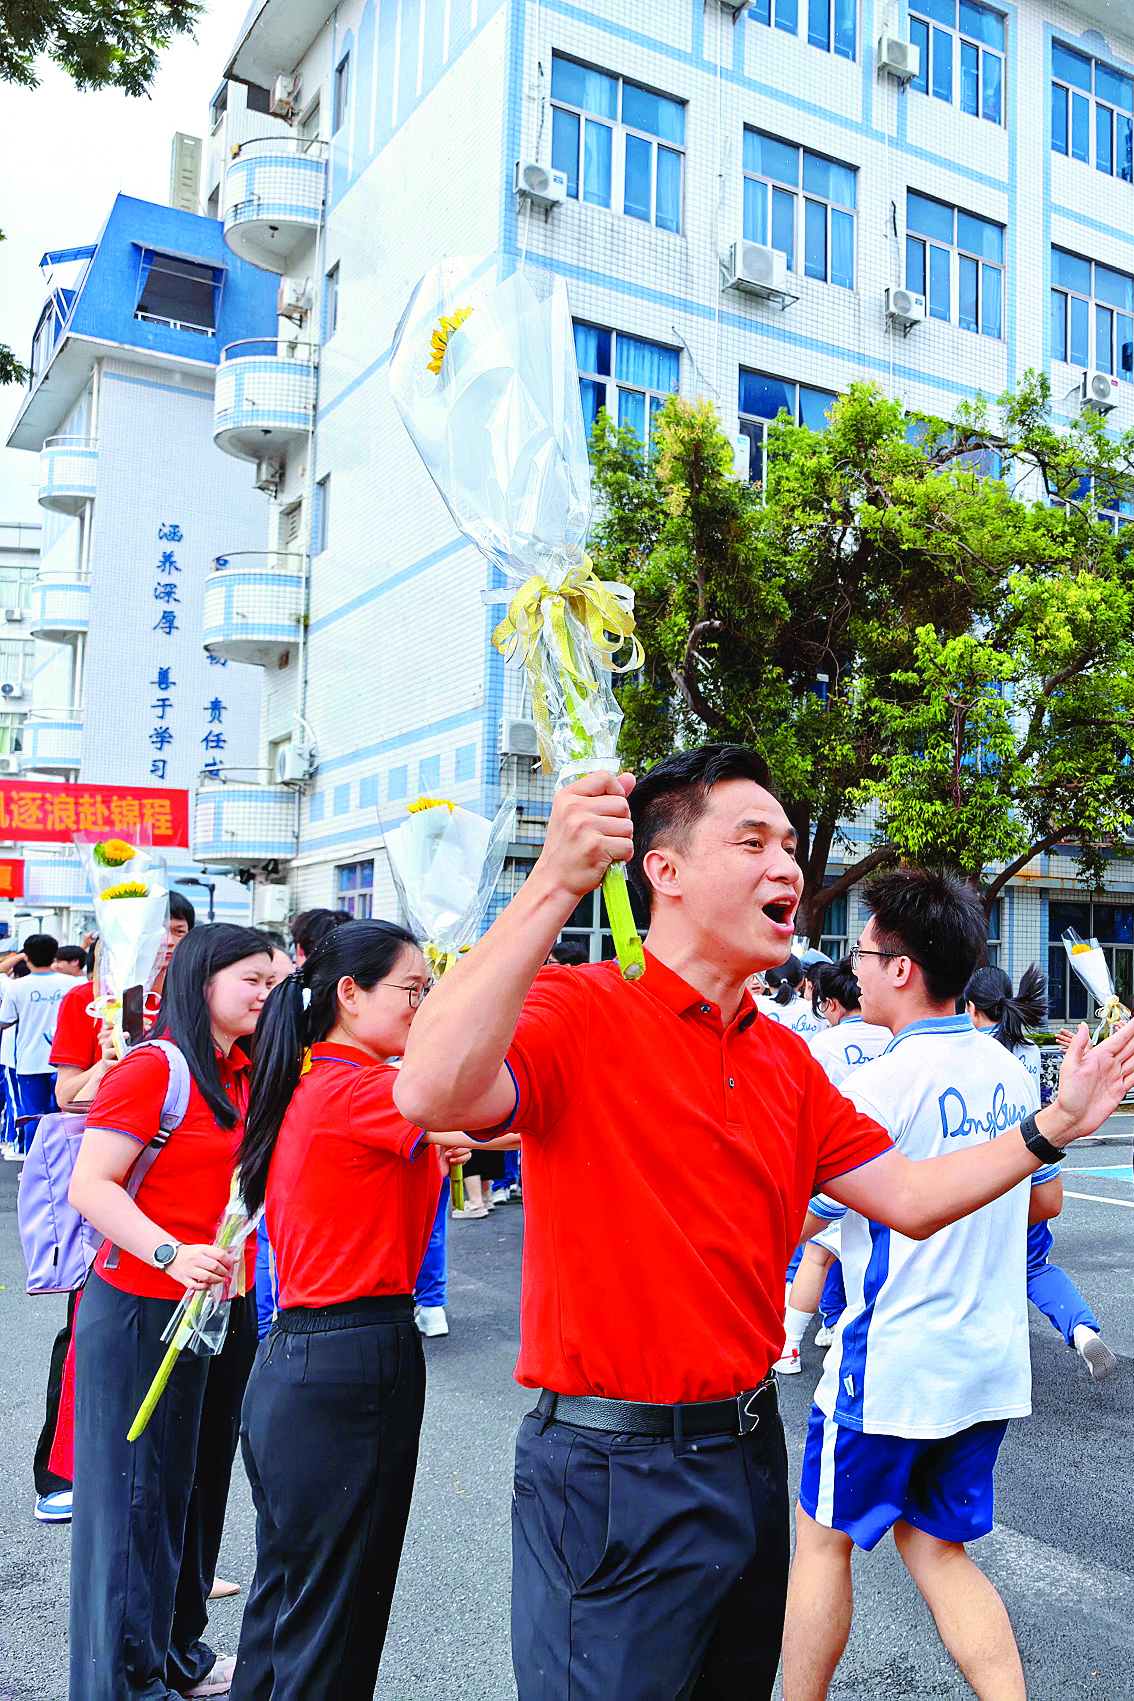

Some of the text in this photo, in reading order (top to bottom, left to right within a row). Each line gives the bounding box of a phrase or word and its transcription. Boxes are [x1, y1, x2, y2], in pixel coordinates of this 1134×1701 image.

[149, 523, 183, 779] 涵养深厚 善于学习
